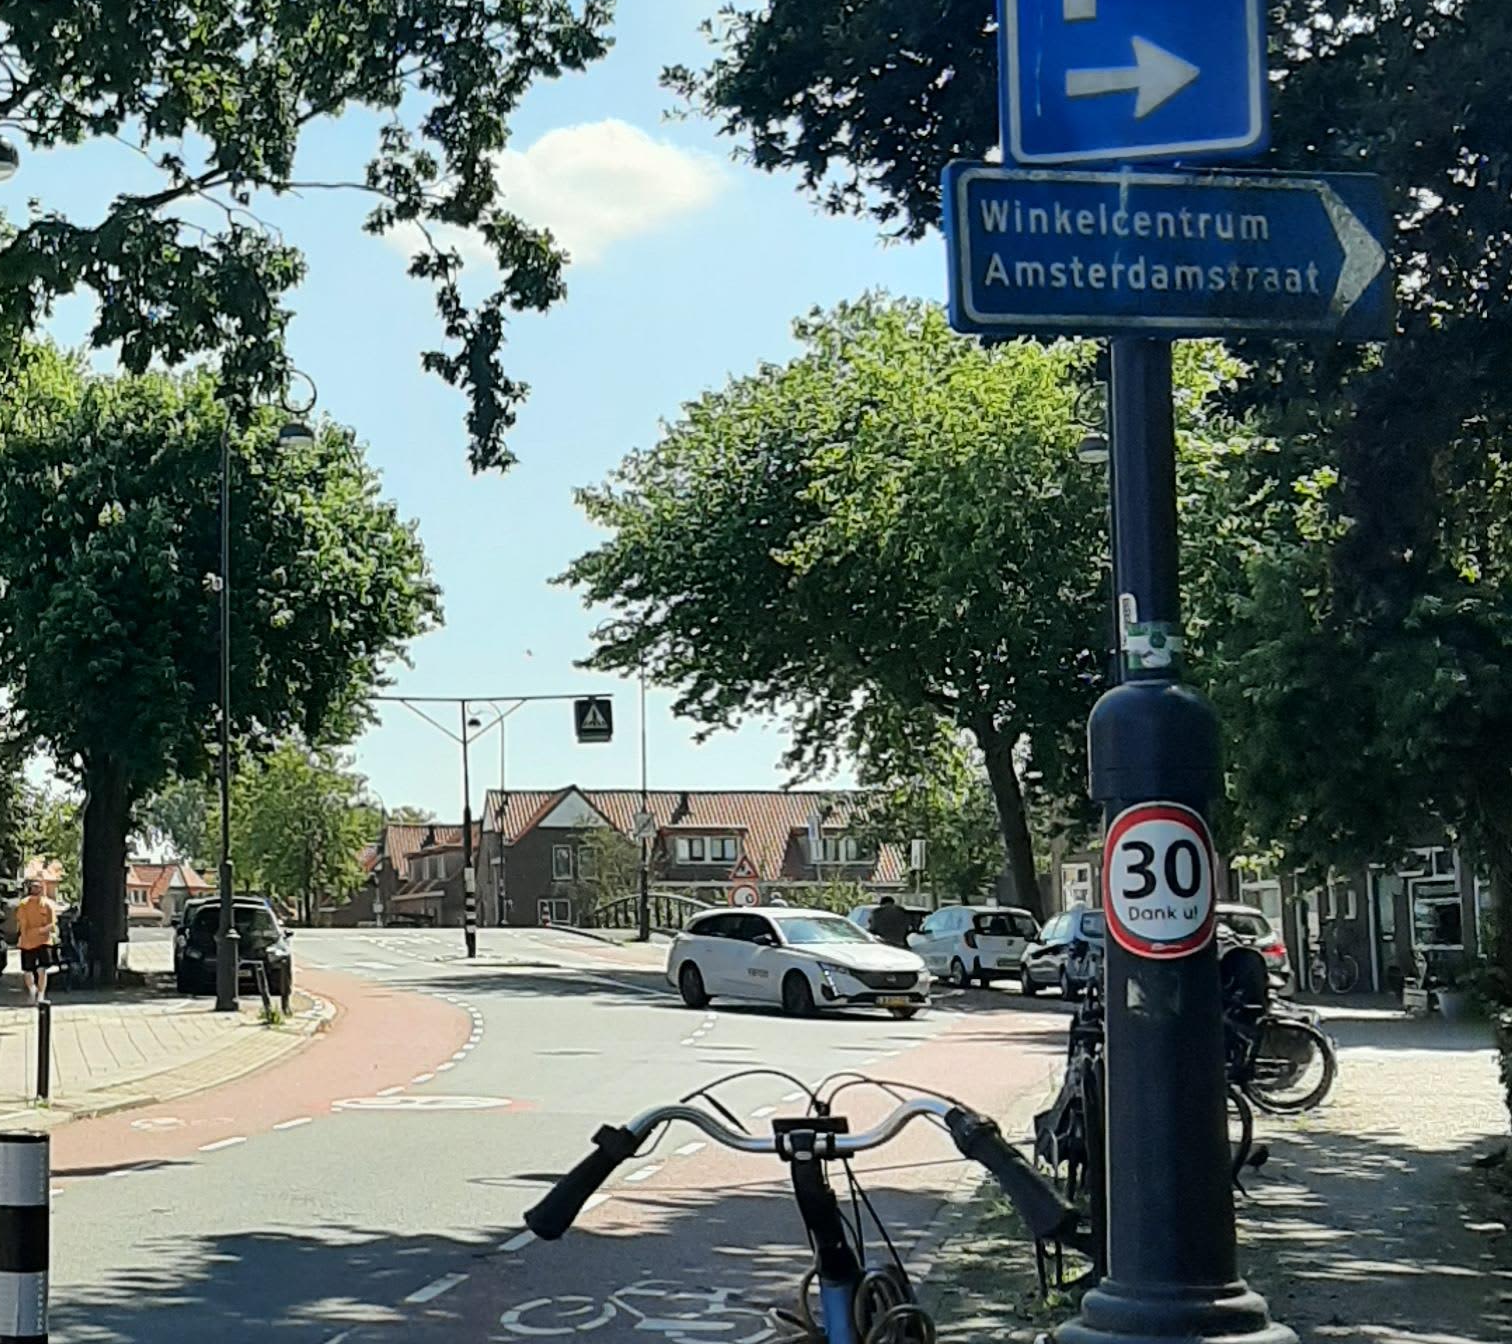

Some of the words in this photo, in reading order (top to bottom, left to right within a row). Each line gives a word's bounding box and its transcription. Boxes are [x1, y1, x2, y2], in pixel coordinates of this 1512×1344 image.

[980, 199, 1270, 240] Winkelcentrum
[984, 252, 1320, 295] Amsterdamstraat
[1121, 839, 1202, 899] 30
[1129, 905, 1177, 921] Dank
[1183, 905, 1198, 920] u!
